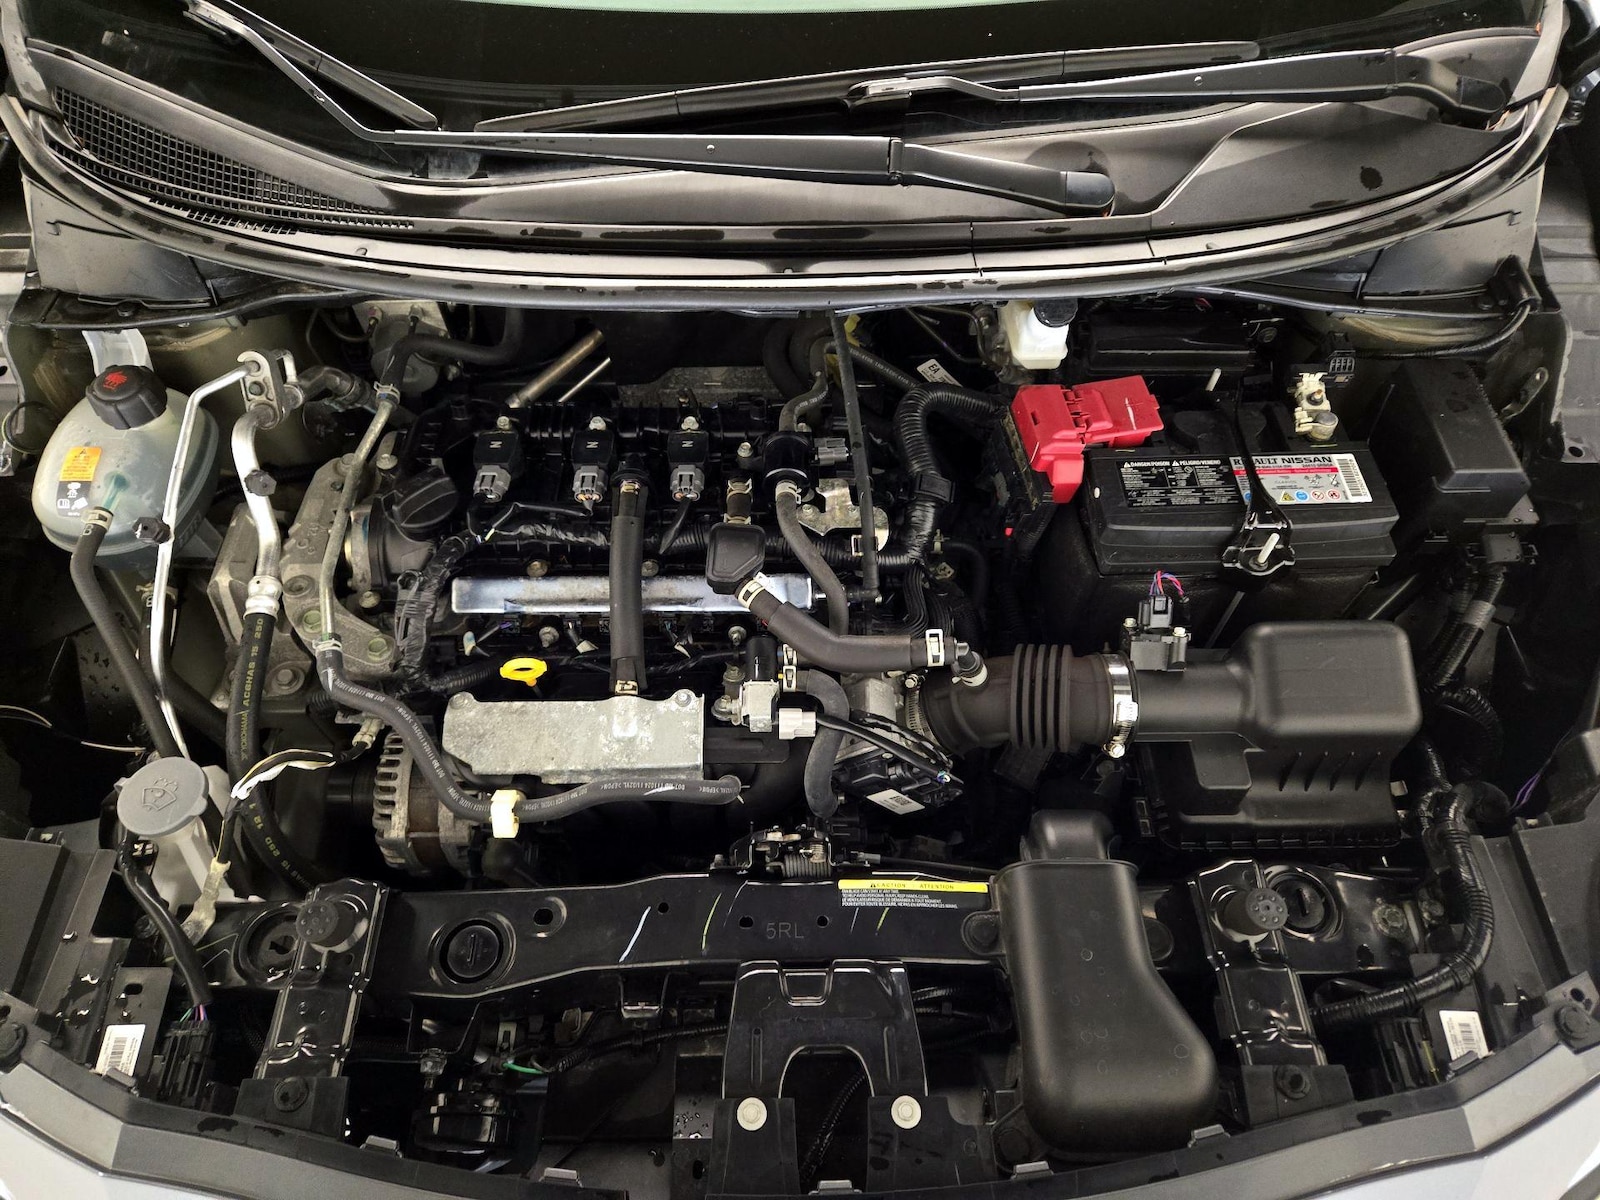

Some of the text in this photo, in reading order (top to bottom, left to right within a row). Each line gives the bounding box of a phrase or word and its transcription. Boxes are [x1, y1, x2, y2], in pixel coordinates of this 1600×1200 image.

[928, 363, 941, 375] EA
[1233, 456, 1333, 466] RAULT NISSAN
[83, 525, 94, 536] B
[766, 922, 805, 940] 5RL
